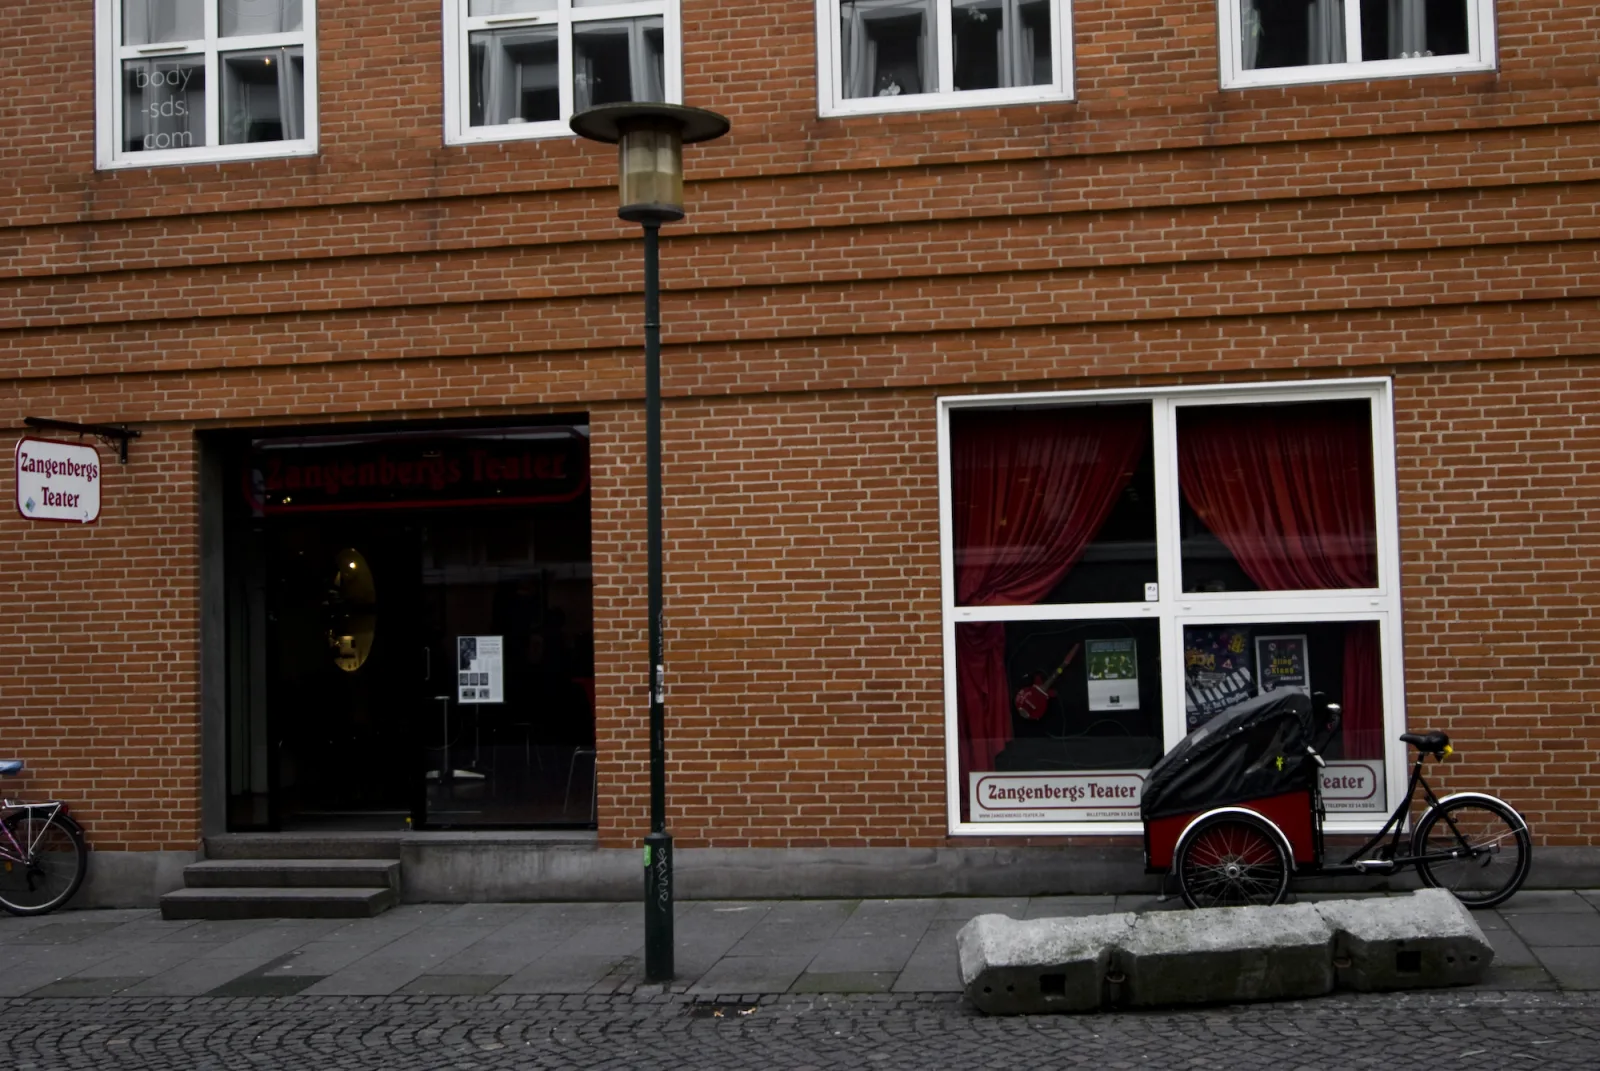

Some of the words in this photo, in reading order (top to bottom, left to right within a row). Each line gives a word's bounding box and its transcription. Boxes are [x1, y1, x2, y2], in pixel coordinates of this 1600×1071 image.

[136, 64, 193, 92] body
[143, 130, 193, 150] com
[21, 452, 98, 482] Zangenbergs
[265, 451, 462, 495] Zangenbergs
[468, 448, 567, 482] Teater
[41, 486, 80, 508] Teater
[988, 784, 1085, 803] Zangenbergs
[1088, 782, 1137, 799] Teater
